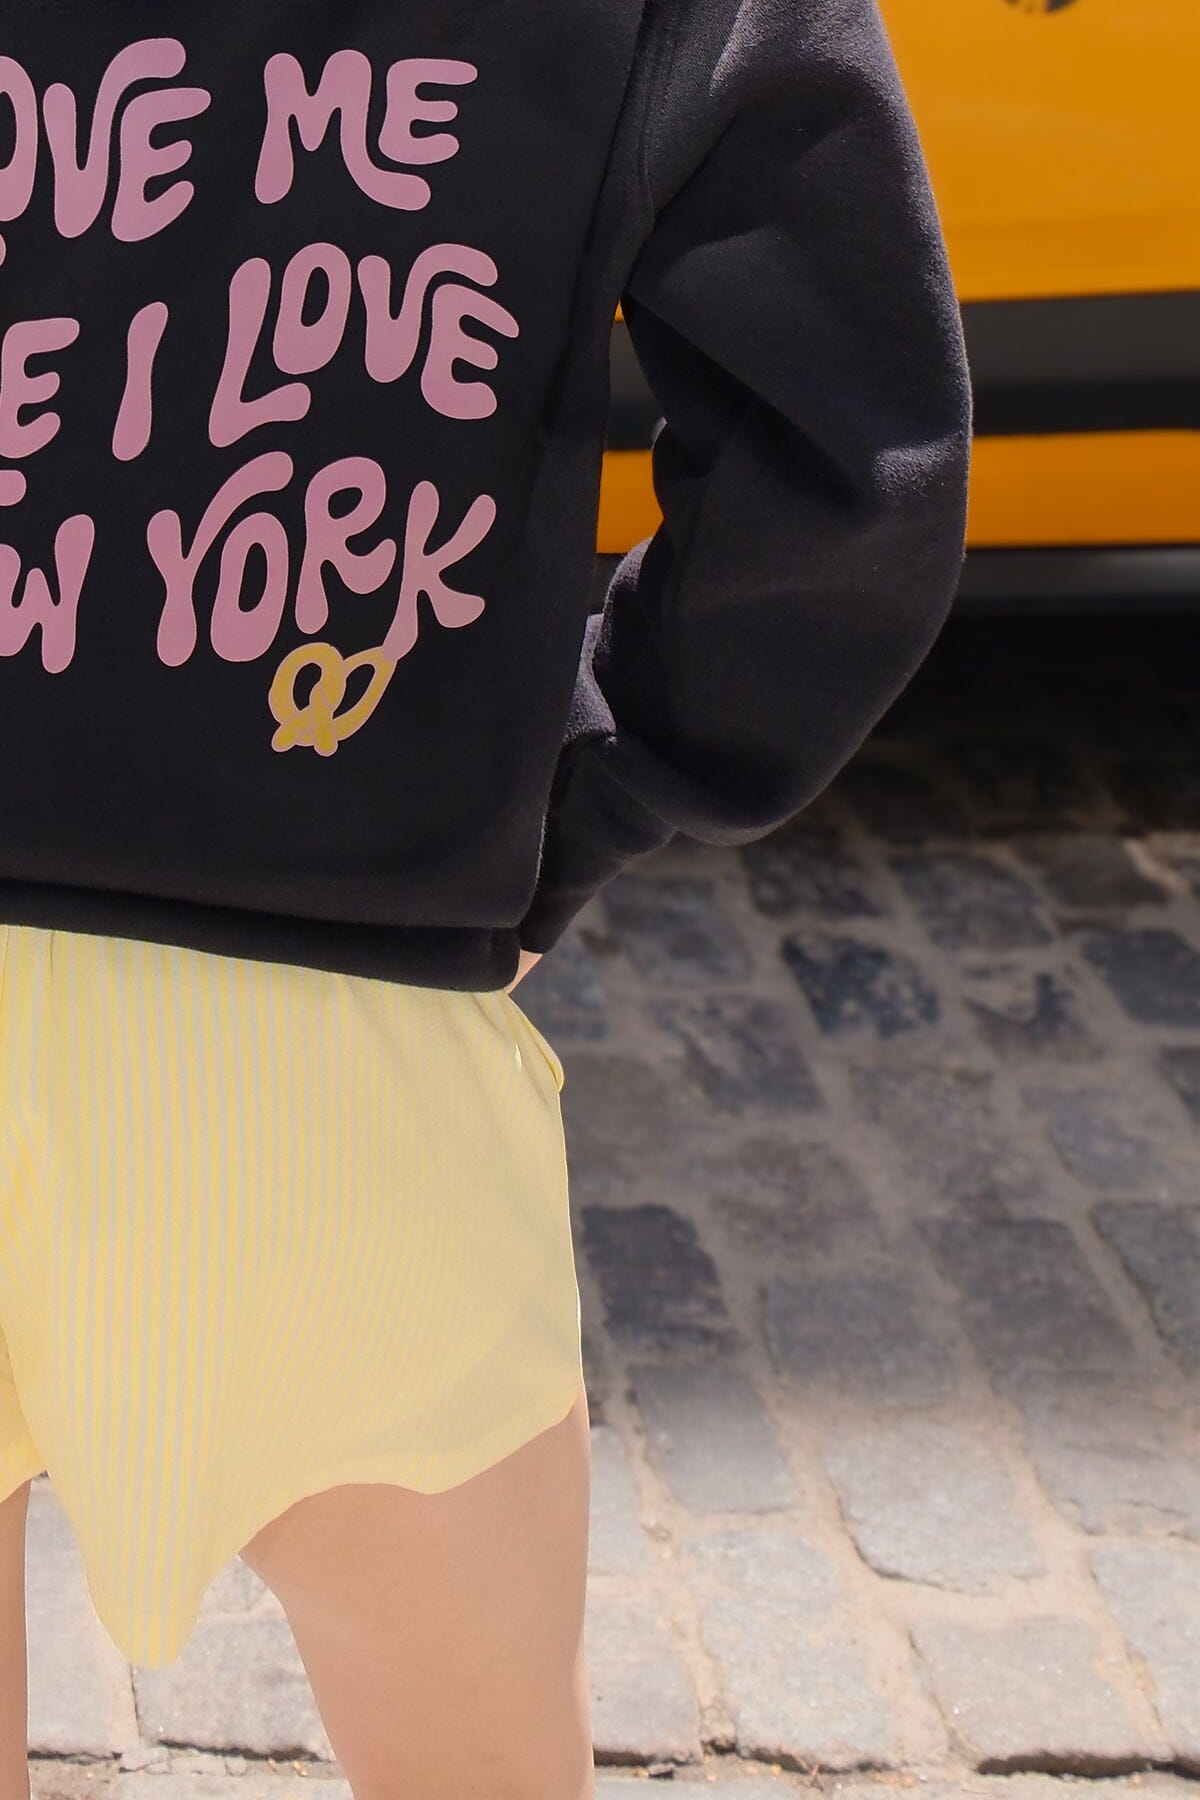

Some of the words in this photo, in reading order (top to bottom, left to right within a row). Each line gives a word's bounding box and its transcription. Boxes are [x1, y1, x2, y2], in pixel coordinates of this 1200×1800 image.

[255, 50, 478, 210] ME
[113, 302, 168, 460] I
[209, 243, 519, 447] LOVE
[147, 452, 497, 667] YORK
